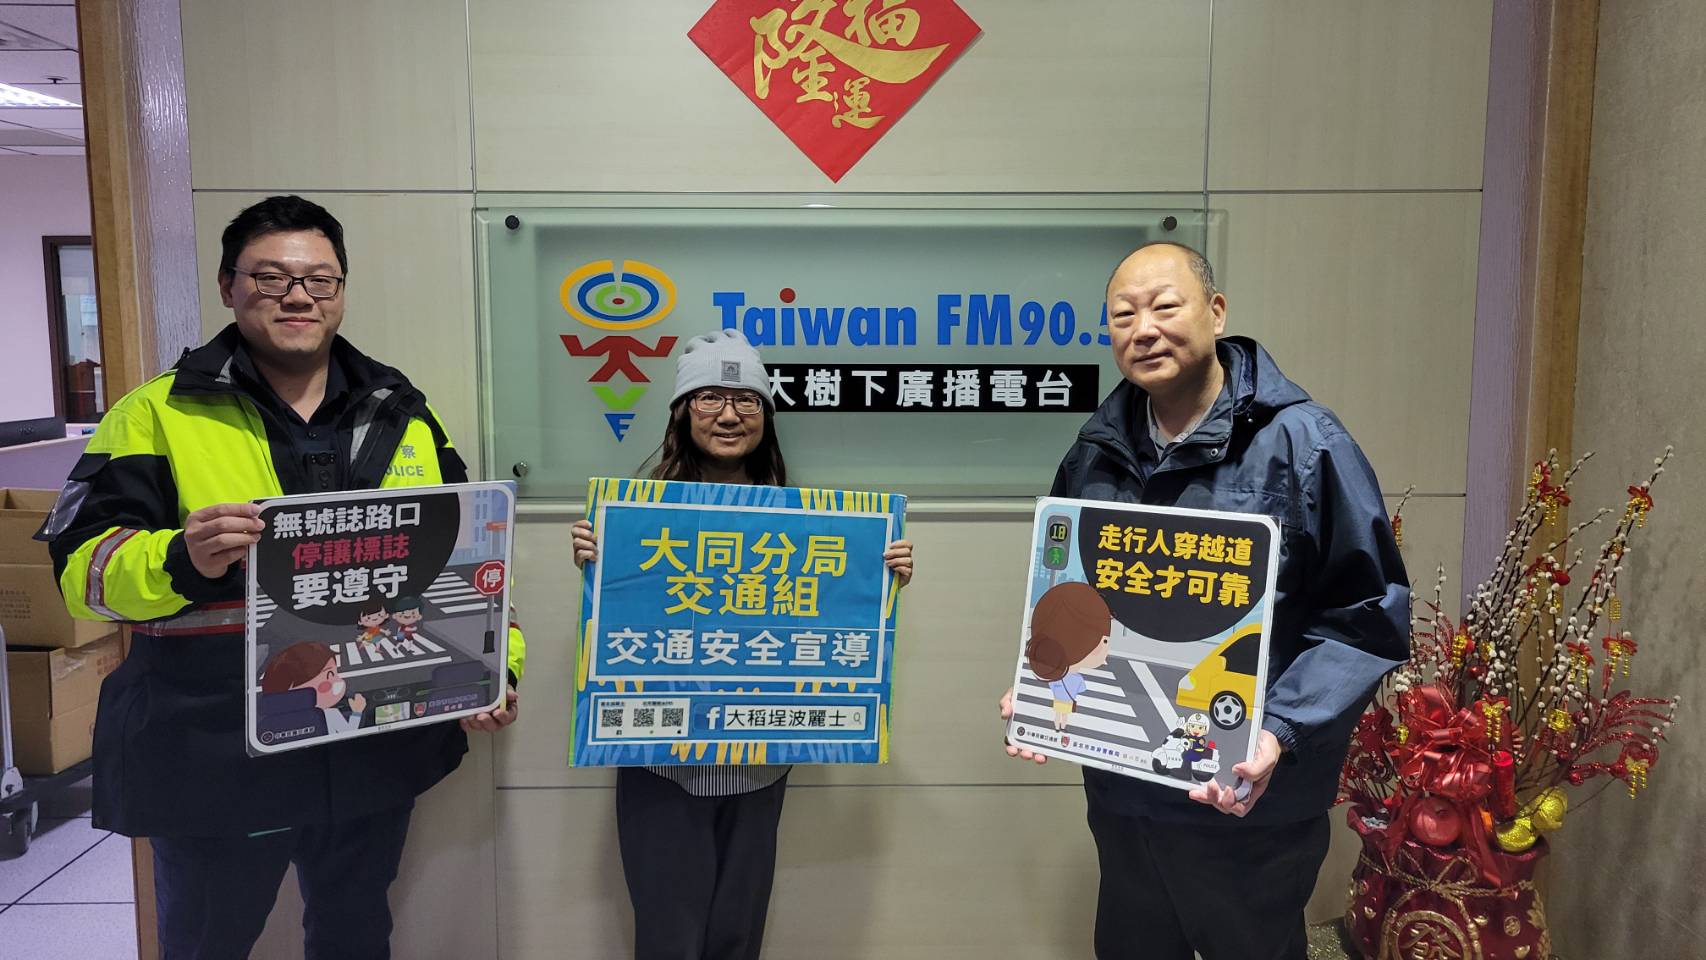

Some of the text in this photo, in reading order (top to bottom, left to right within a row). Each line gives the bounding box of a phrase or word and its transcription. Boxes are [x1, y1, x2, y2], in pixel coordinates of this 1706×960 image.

[713, 287, 917, 347] Taiwan
[768, 368, 1073, 408] 大樹下廣播電台
[273, 502, 421, 540] 無號誌路口
[1051, 525, 1066, 540] 18
[291, 533, 410, 570] 停讓標誌
[638, 527, 848, 577] 大同分局
[1097, 523, 1253, 566] 走行人穿越道
[291, 564, 408, 611] 要遵守
[482, 567, 502, 589] 停
[664, 571, 819, 617] 交通組
[1095, 558, 1252, 608] 安全才可靠
[606, 627, 871, 668] 交通安全宣導
[726, 709, 848, 728] 大稻埕波麗士
